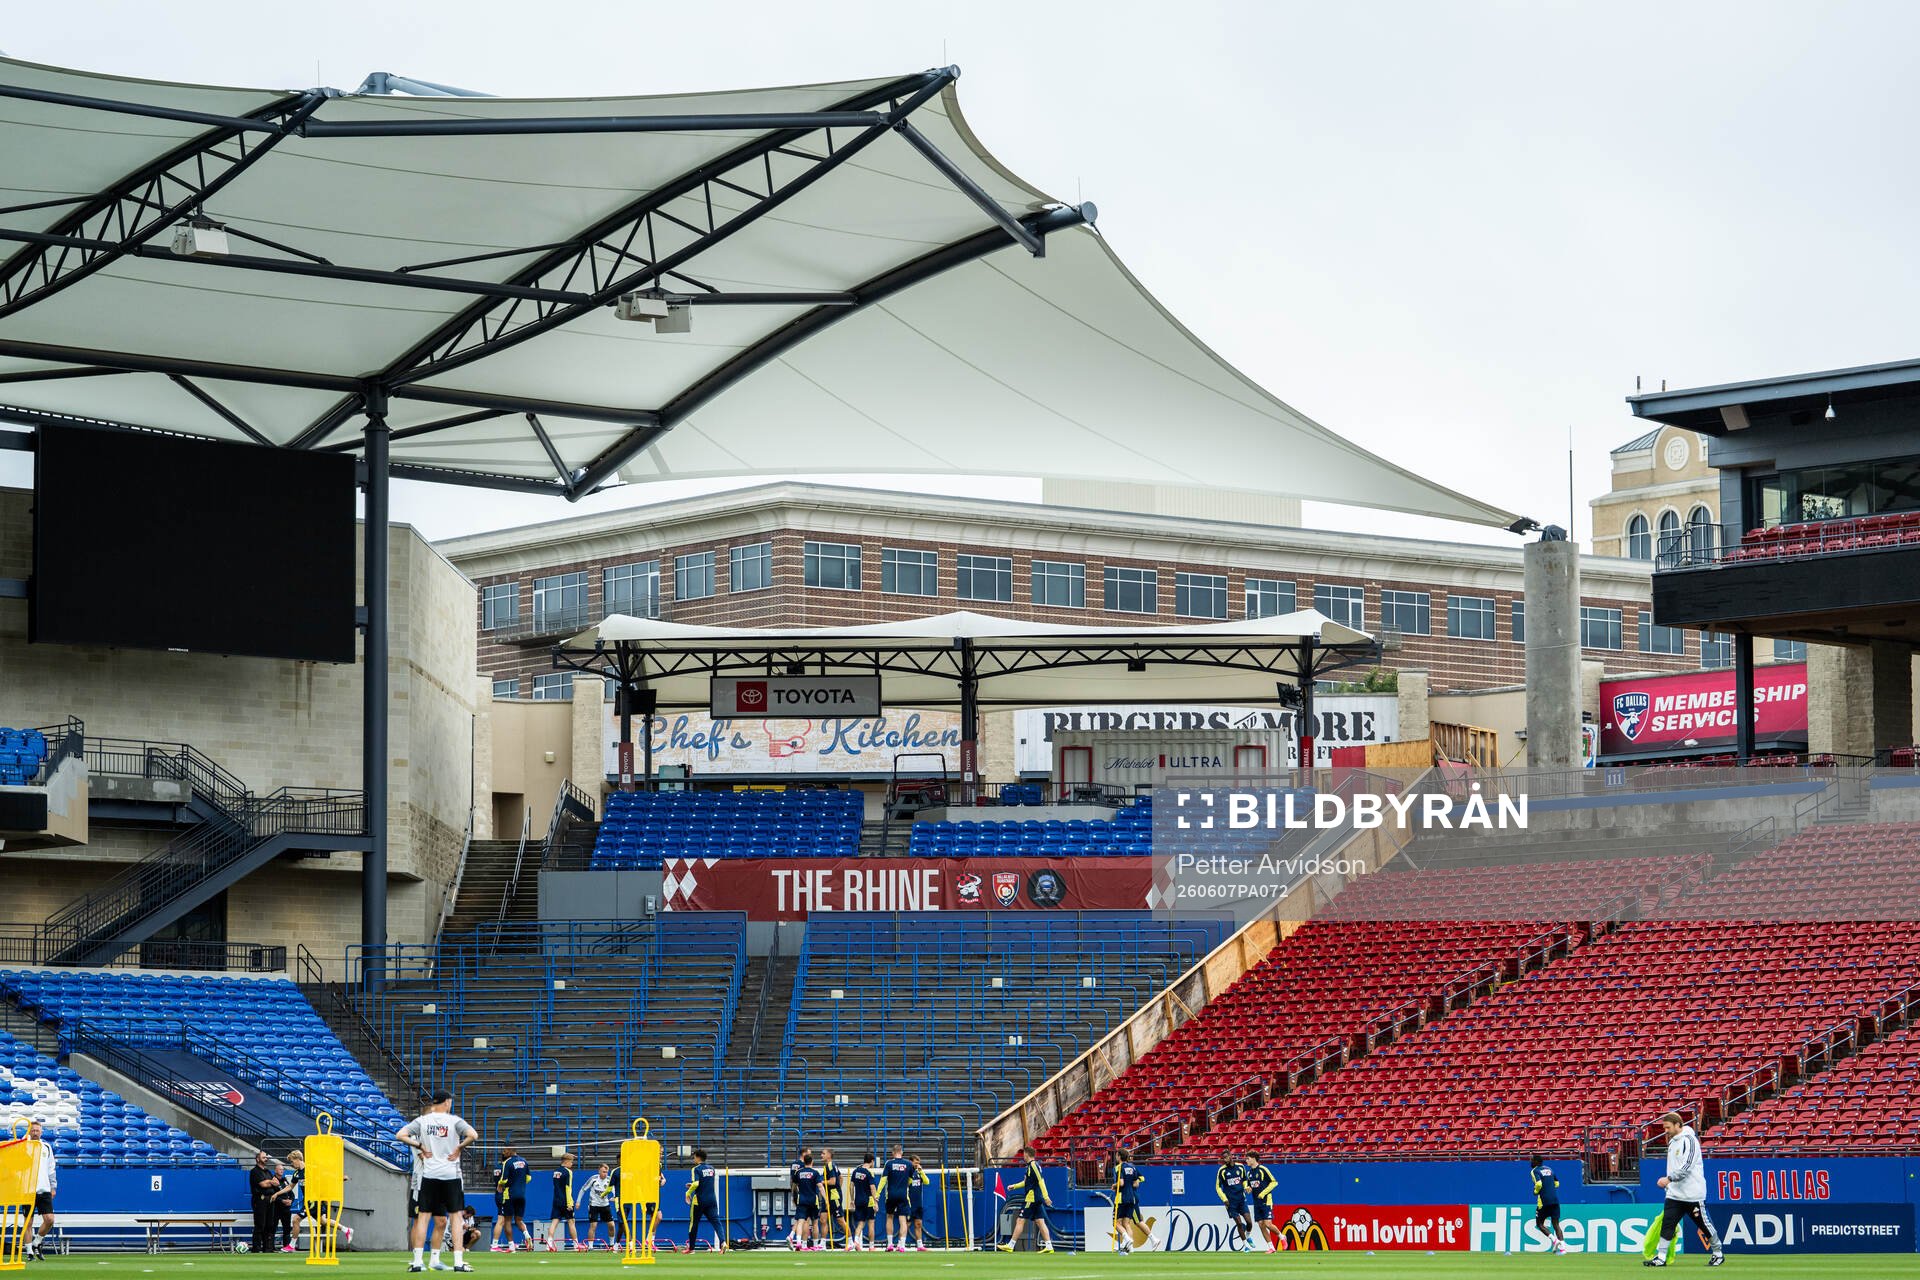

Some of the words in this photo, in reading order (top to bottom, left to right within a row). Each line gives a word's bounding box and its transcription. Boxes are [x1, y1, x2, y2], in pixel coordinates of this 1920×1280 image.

[774, 689, 855, 704] TOYOTA
[1616, 698, 1624, 709] FC
[1625, 695, 1647, 707] DALLAS
[1654, 684, 1806, 712] MEMBESHIP
[819, 713, 962, 755] Kitchen
[1043, 712, 1229, 742] BURGERS
[1104, 756, 1155, 770] Michelob
[1170, 756, 1222, 768] ULTRA
[1607, 774, 1622, 785] 111
[771, 870, 832, 911] THE
[844, 870, 939, 911] RHINE
[153, 1180, 160, 1190] 6
[1717, 1170, 1741, 1200] FC
[1752, 1170, 1830, 1200] DALLAS
[1165, 1208, 1246, 1252] Dove
[1334, 1216, 1367, 1242] i’m
[1373, 1217, 1433, 1244] lovin’
[1470, 1207, 1683, 1254] Hisens
[1723, 1214, 1795, 1245] ADI
[1811, 1225, 1900, 1236] PREDICTSTREET
